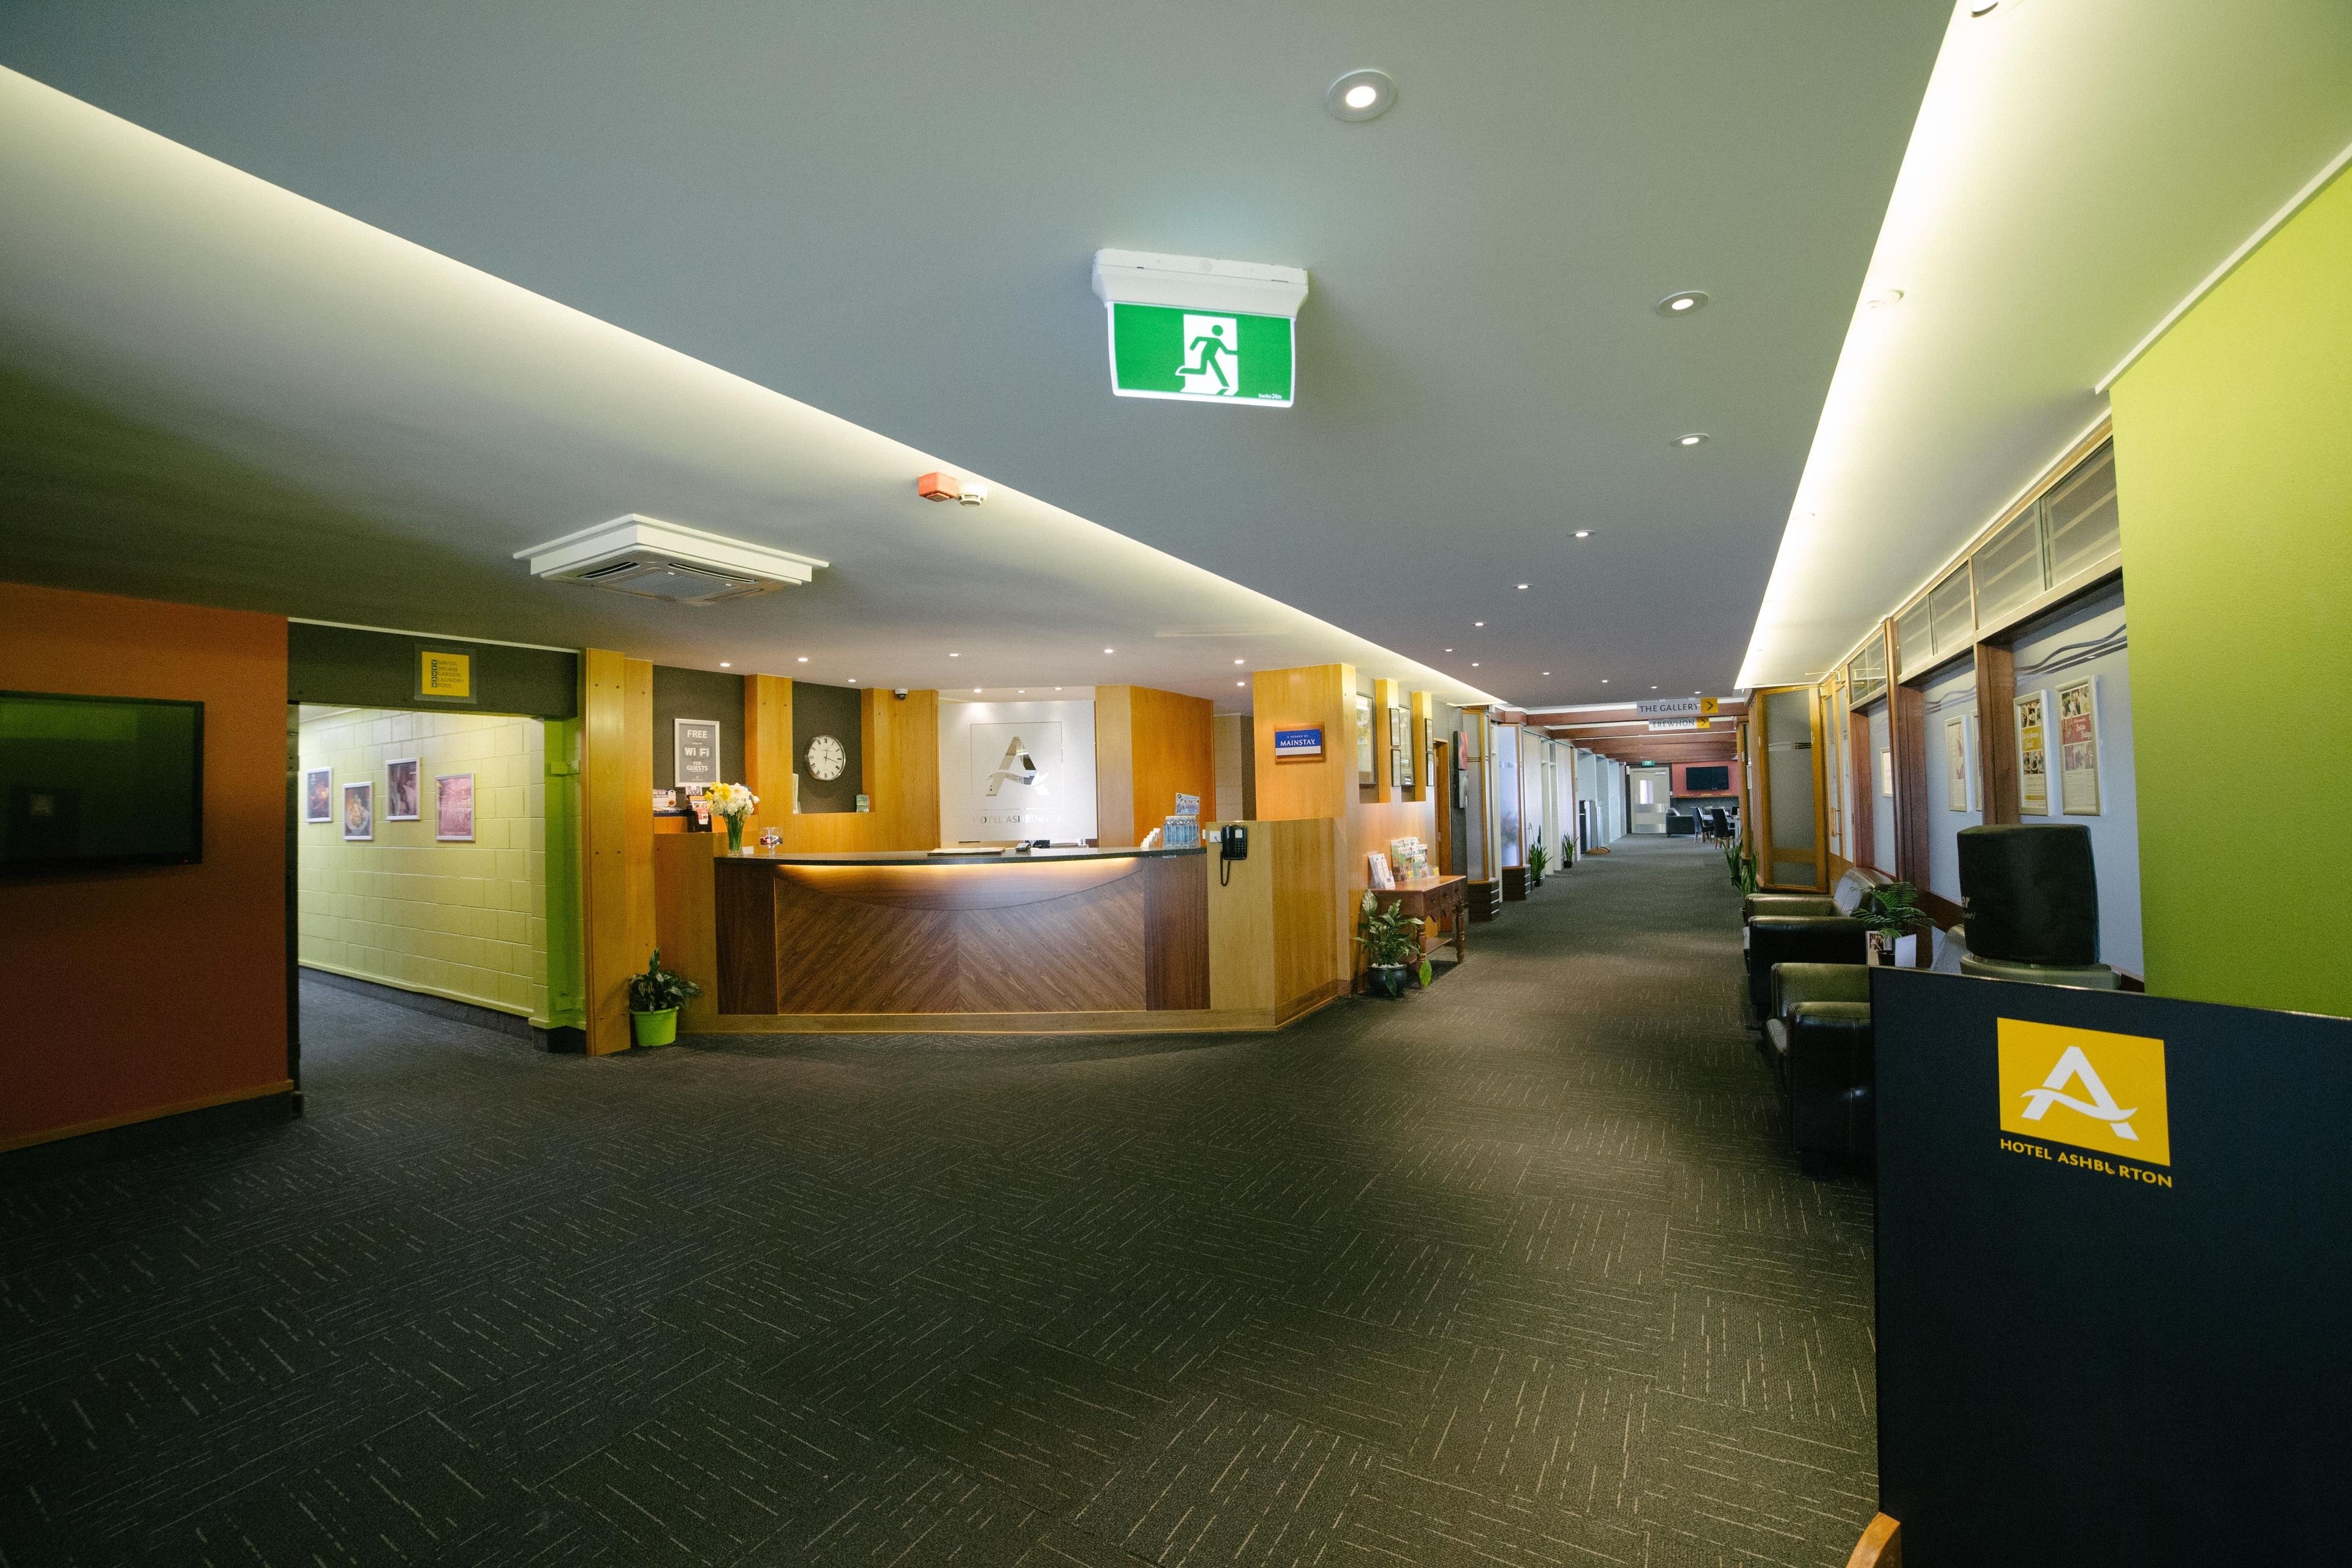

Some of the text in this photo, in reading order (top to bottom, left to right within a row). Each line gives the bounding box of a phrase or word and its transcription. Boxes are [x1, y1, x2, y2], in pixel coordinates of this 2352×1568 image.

[1659, 703, 1699, 712] GALLERY
[687, 729, 707, 739] FREE
[684, 747, 709, 756] Wi Fi
[2000, 1139, 2052, 1161] HOTEL
